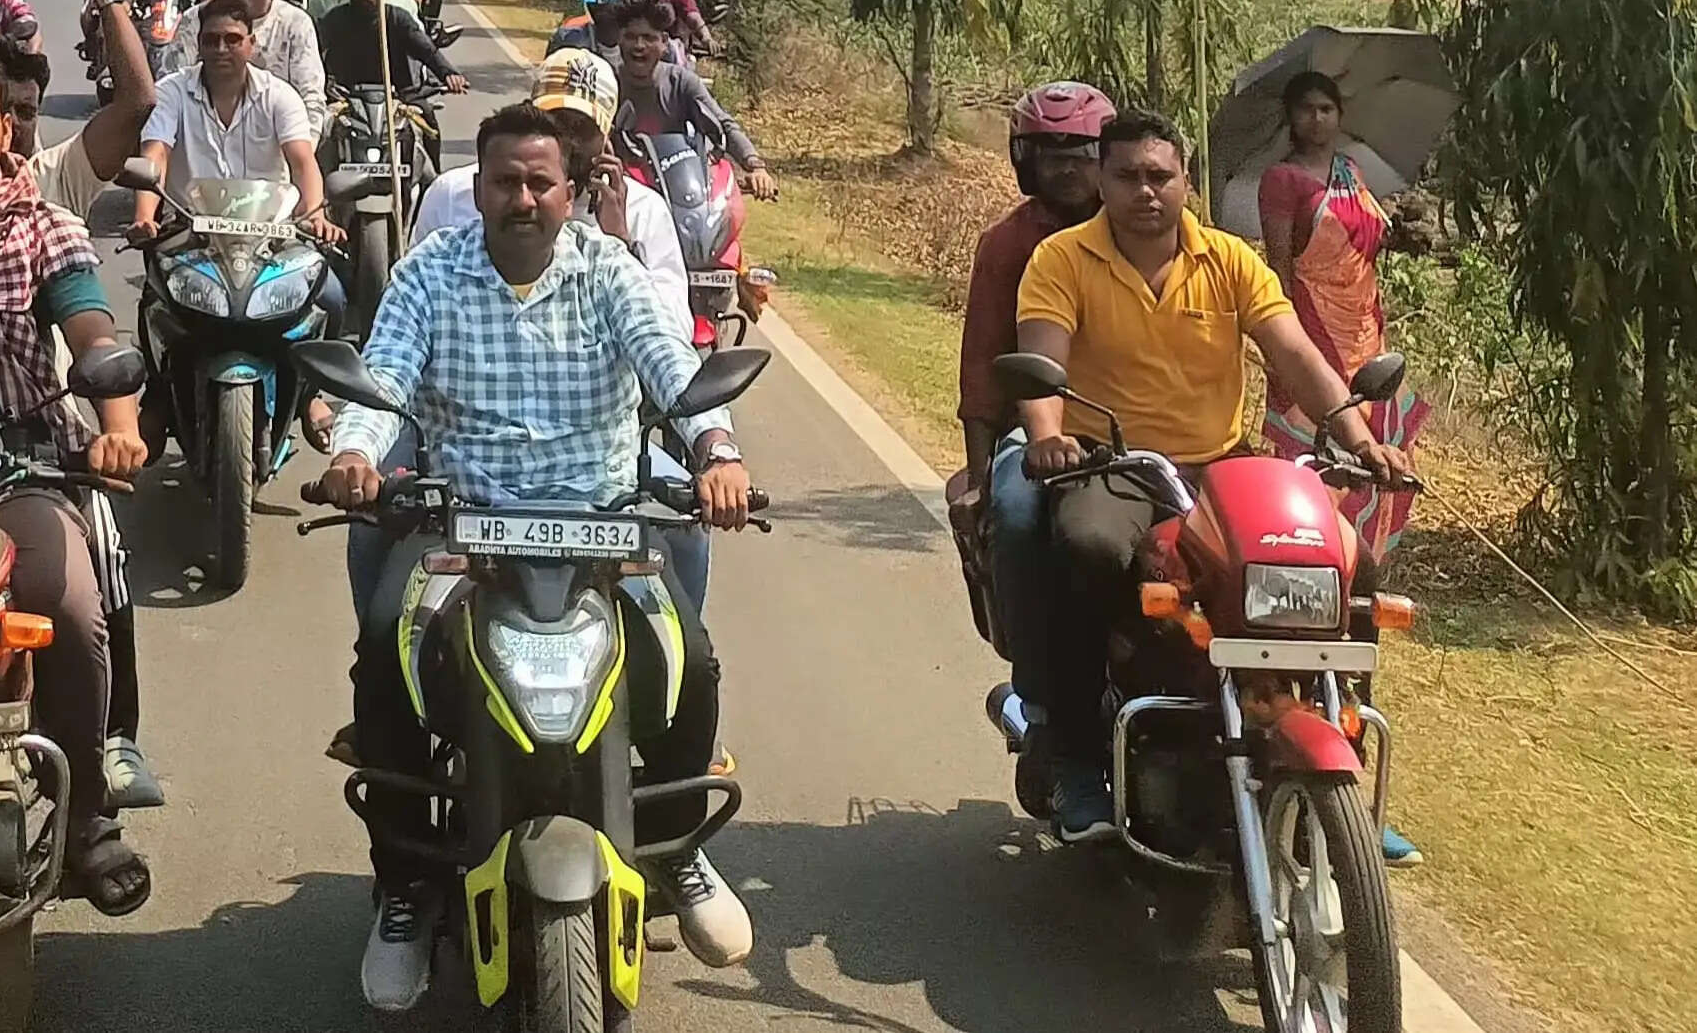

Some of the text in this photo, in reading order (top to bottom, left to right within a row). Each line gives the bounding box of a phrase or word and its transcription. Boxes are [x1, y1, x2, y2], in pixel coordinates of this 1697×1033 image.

[481, 519, 635, 548] WB 49B 3634
